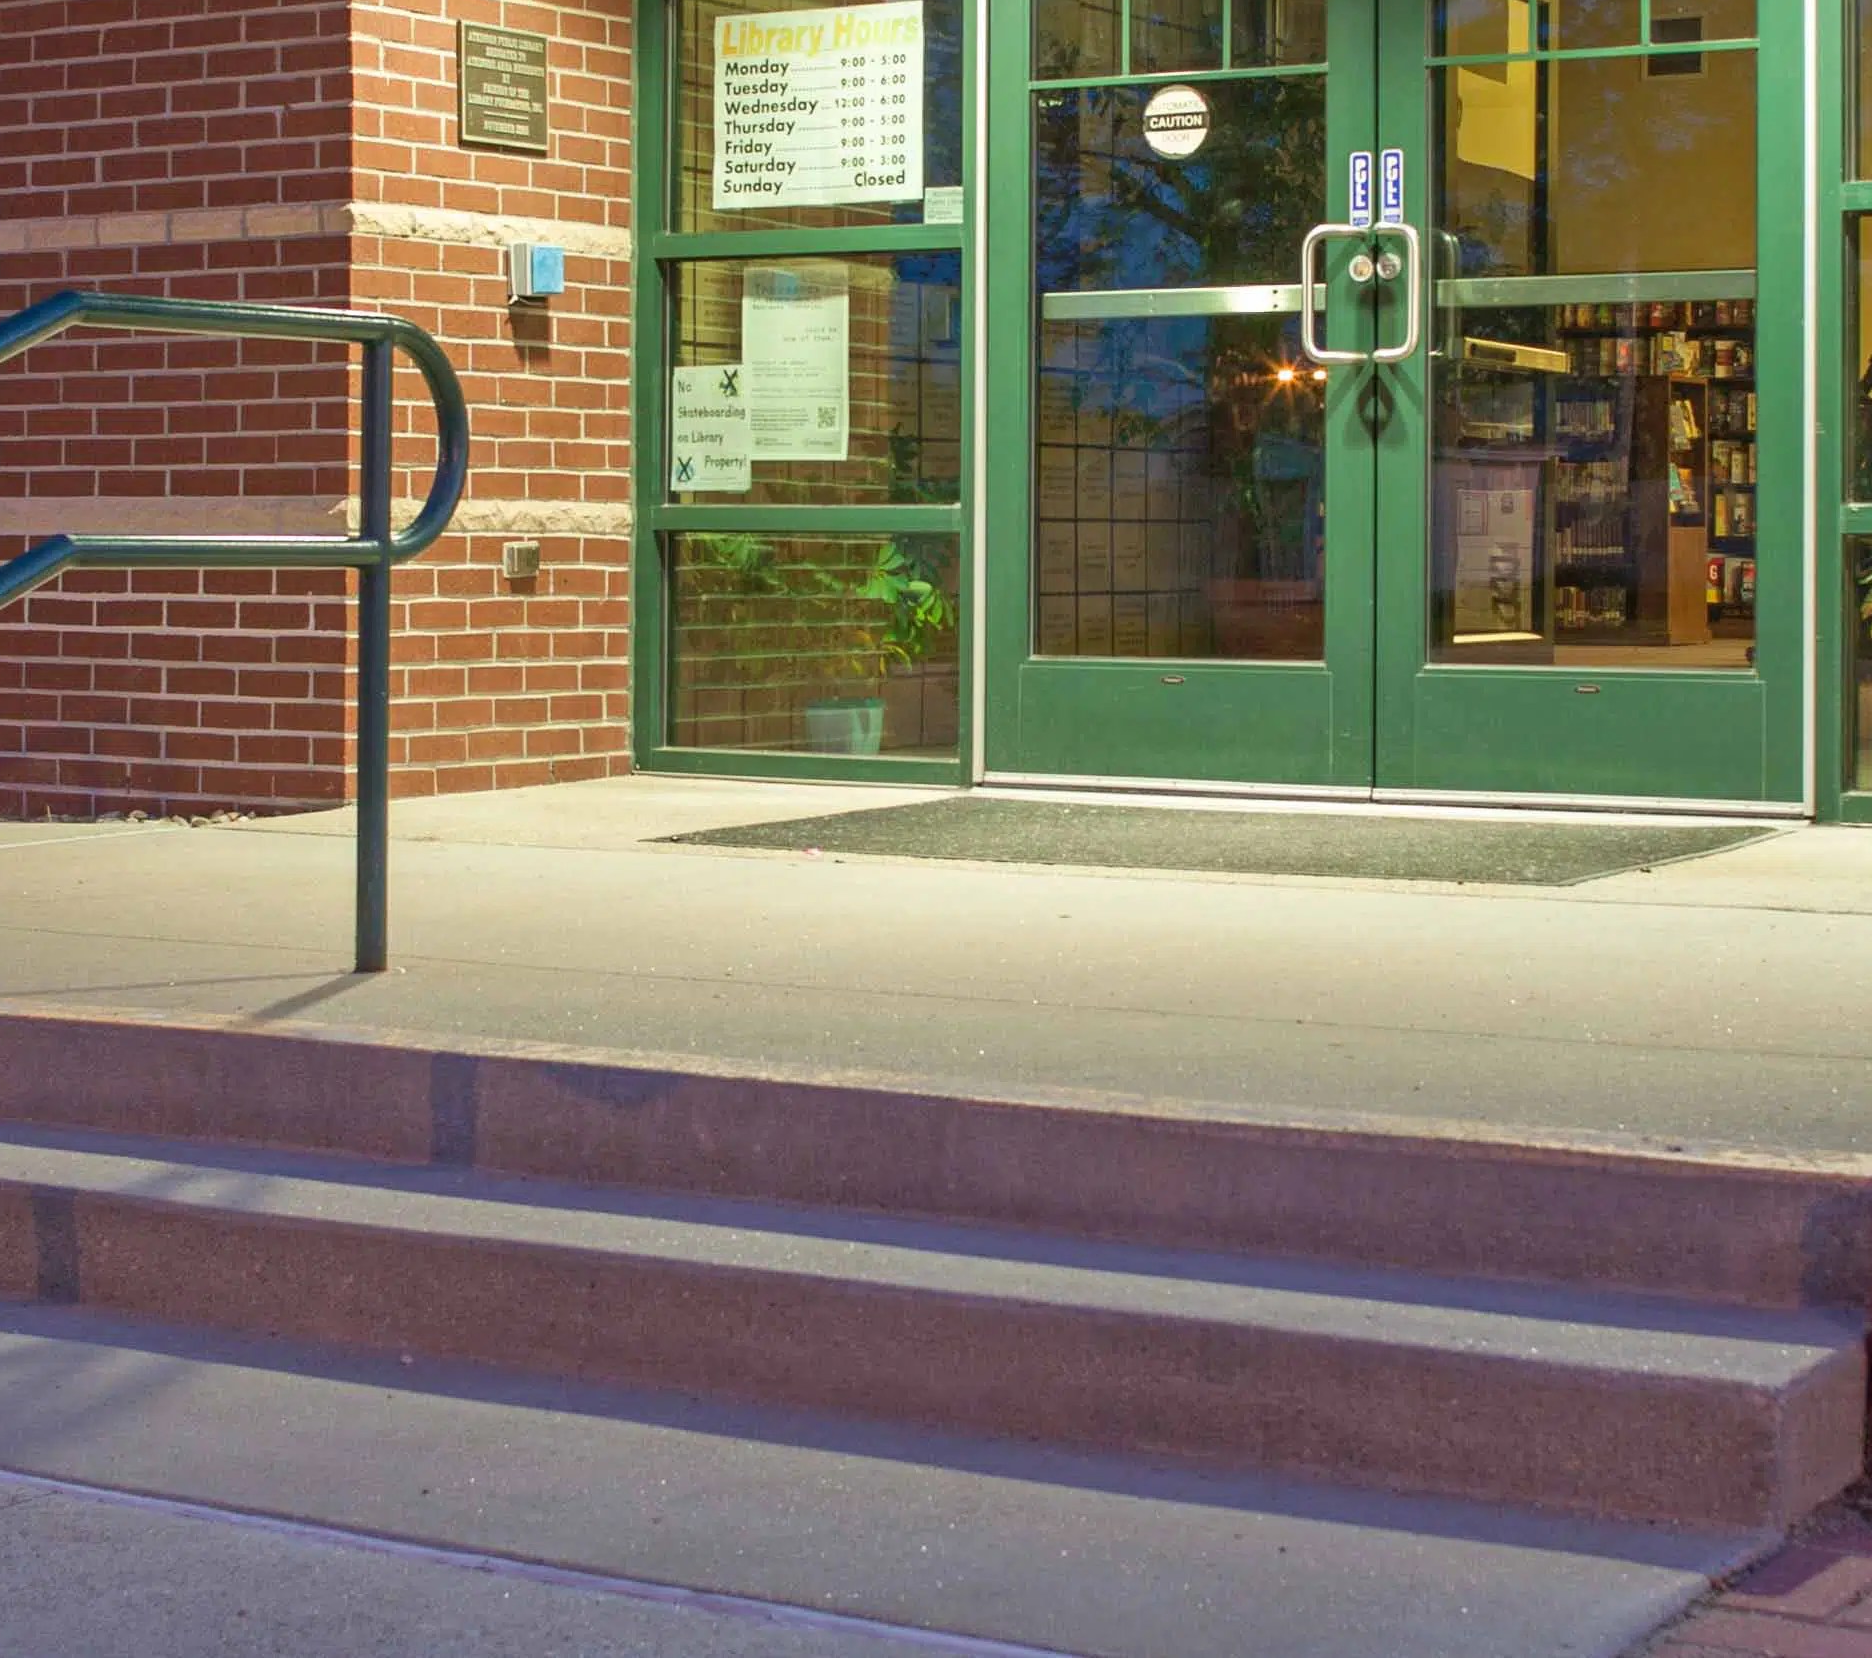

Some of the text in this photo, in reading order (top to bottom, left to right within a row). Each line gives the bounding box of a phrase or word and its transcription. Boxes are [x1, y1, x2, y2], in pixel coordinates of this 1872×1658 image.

[722, 12, 921, 59] Library Hours
[725, 58, 790, 77] Monday
[840, 56, 866, 68] 9:00
[880, 53, 907, 66] 5:00
[724, 78, 789, 97] Tuesday
[840, 76, 866, 88] 9:00
[880, 74, 906, 86] 6:00
[724, 96, 819, 115] Wednesday
[835, 97, 866, 108] 12:00
[880, 94, 906, 105] 6:00
[724, 117, 796, 136] Thursday
[840, 116, 866, 127] 9:00
[880, 114, 906, 125] 5:00
[1149, 114, 1203, 129] CAUTION
[725, 140, 773, 157] Friday
[840, 136, 866, 148] 9:00
[880, 133, 906, 145] 3:00
[724, 157, 796, 175] Saturday
[840, 156, 866, 168] 9:00
[880, 153, 906, 165] 3:00
[723, 170, 906, 196] Sunday Closed
[678, 404, 746, 420] Skateboarding
[691, 430, 723, 446] Library
